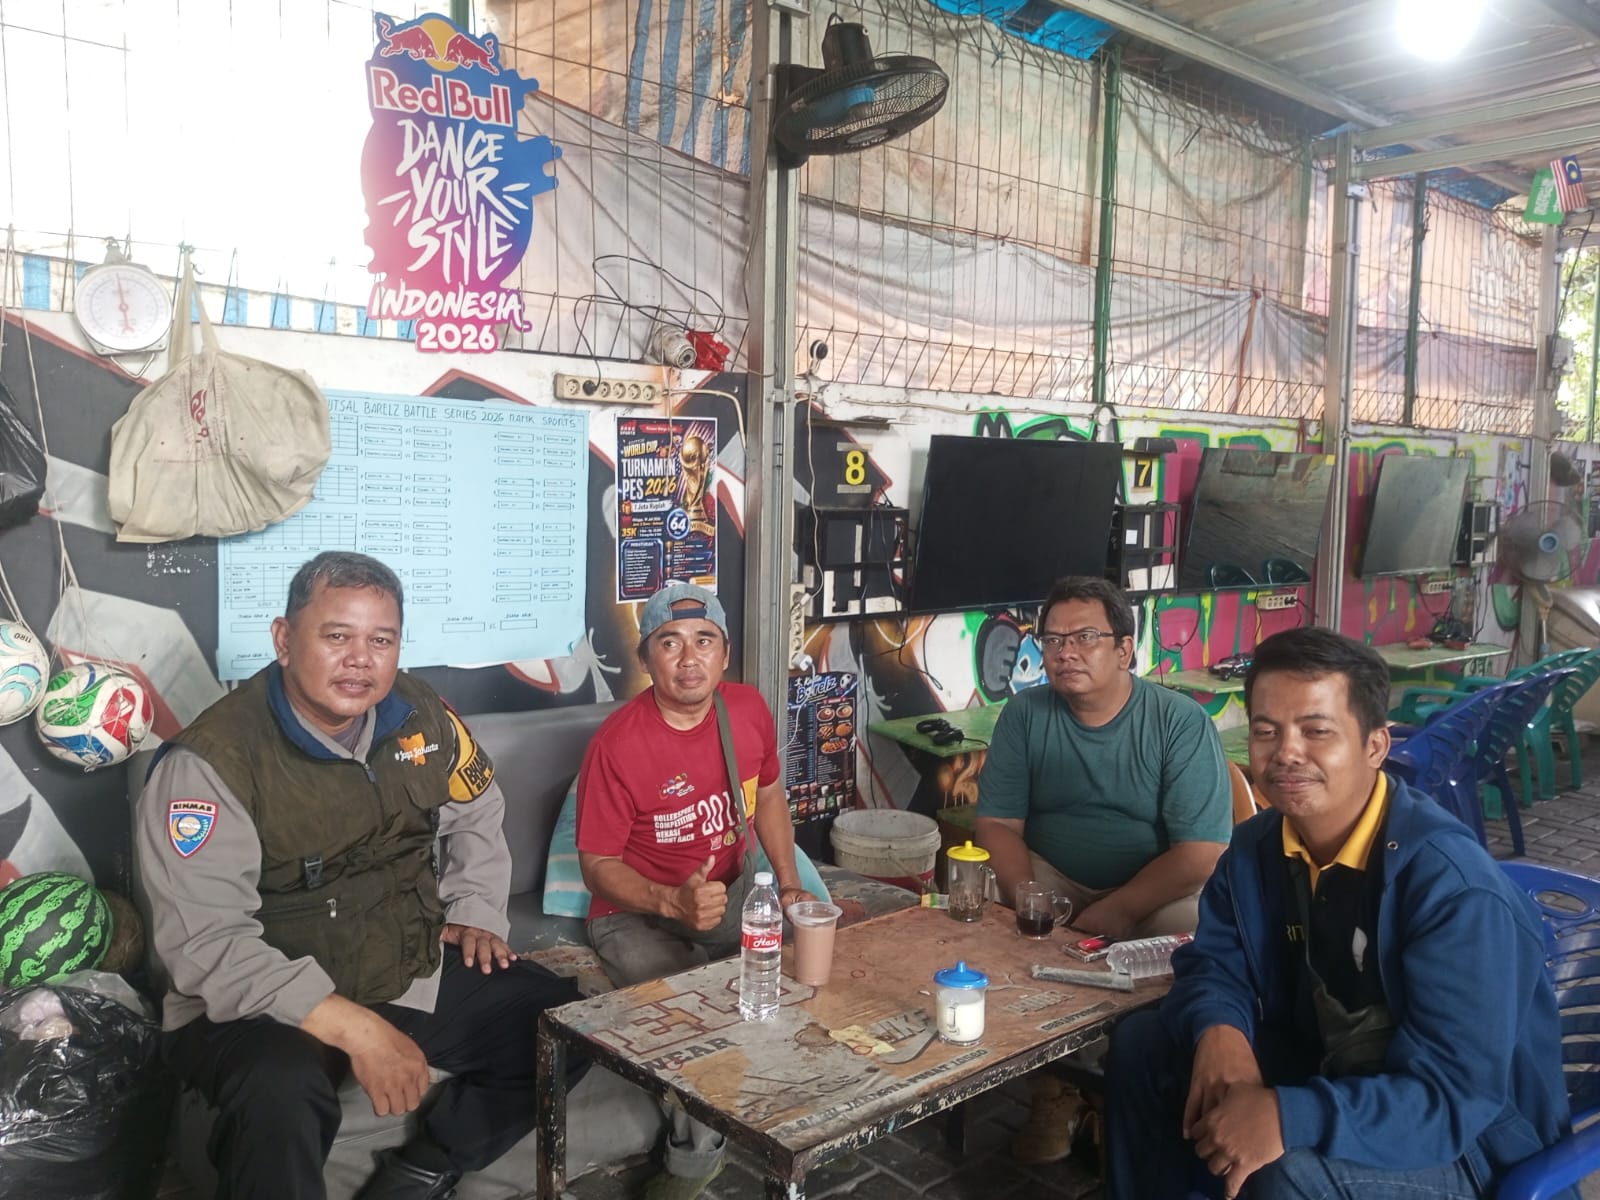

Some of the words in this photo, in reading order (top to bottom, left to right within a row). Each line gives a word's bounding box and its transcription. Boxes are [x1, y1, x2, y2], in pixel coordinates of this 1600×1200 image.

[371, 68, 446, 116] Red
[447, 80, 512, 125] Bull
[396, 119, 504, 180] DANCE
[410, 160, 520, 225] YOUR
[407, 203, 513, 285] STYLE
[371, 279, 522, 327] INDONESIA
[419, 322, 495, 350] 2026
[364, 401, 400, 417] BARELZ
[404, 404, 438, 419] BATTLE
[623, 442, 646, 458] WORLD
[845, 450, 866, 486] 8
[1136, 458, 1153, 487] 7
[622, 478, 644, 501] PES
[621, 528, 638, 538] 35K
[670, 516, 687, 532] 64
[697, 791, 746, 836] 201
